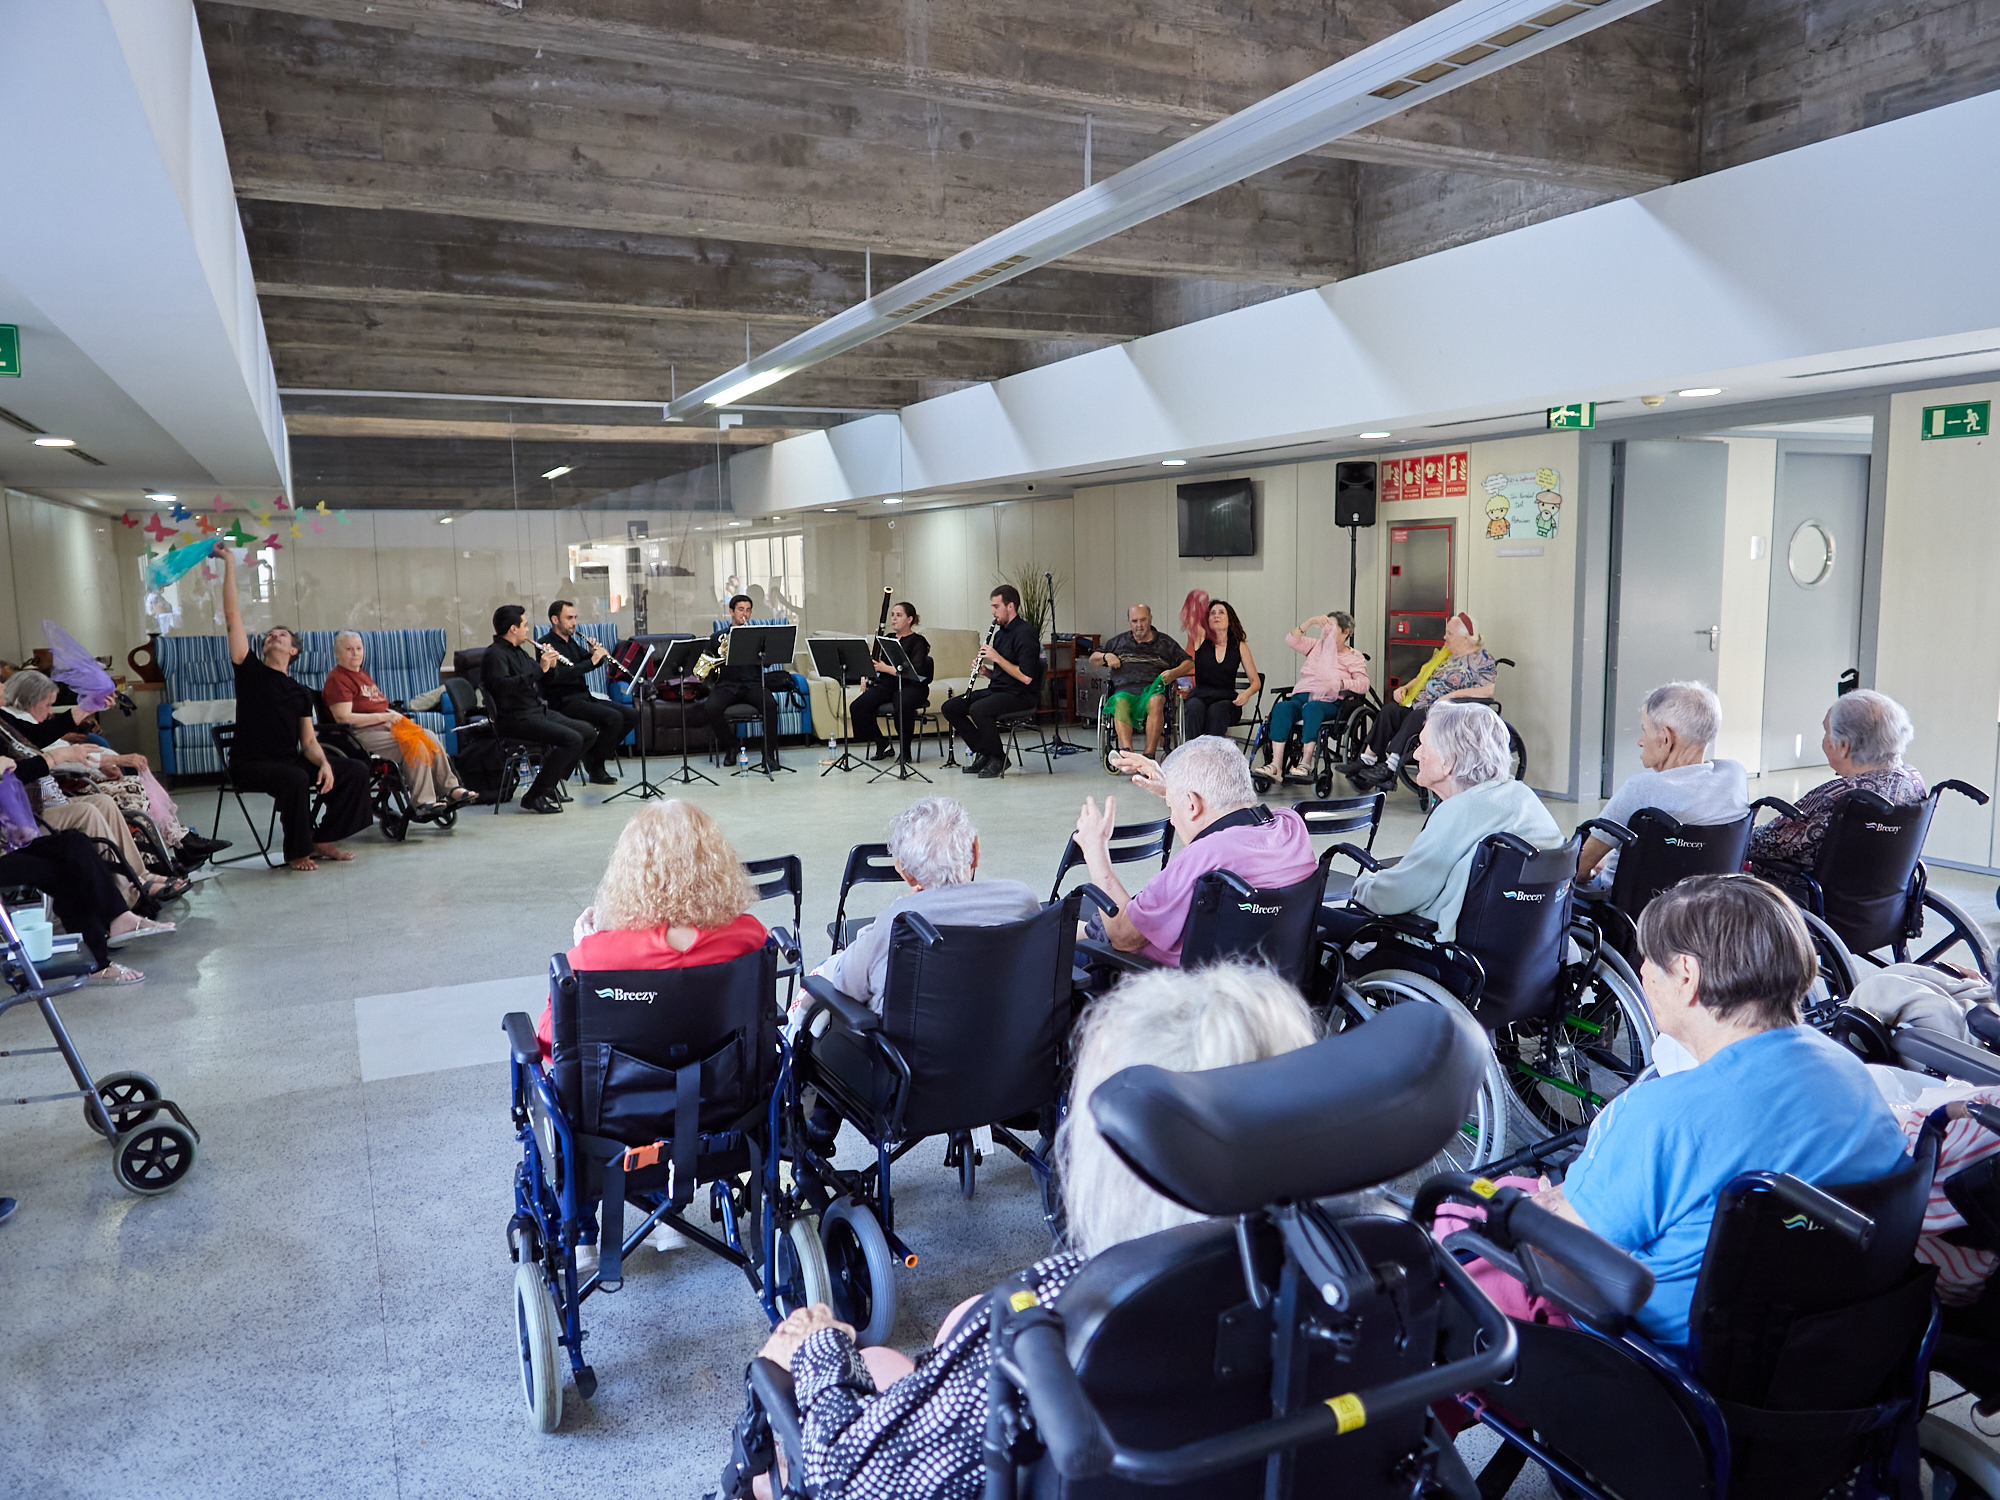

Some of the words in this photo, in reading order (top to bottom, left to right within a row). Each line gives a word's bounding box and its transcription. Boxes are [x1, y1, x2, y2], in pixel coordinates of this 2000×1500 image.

[1876, 823, 1899, 834] Breezy
[1677, 838, 1703, 850] Breezy
[1516, 891, 1543, 903] Breezy
[1252, 904, 1279, 916] Breezy
[614, 988, 656, 1004] Breezy
